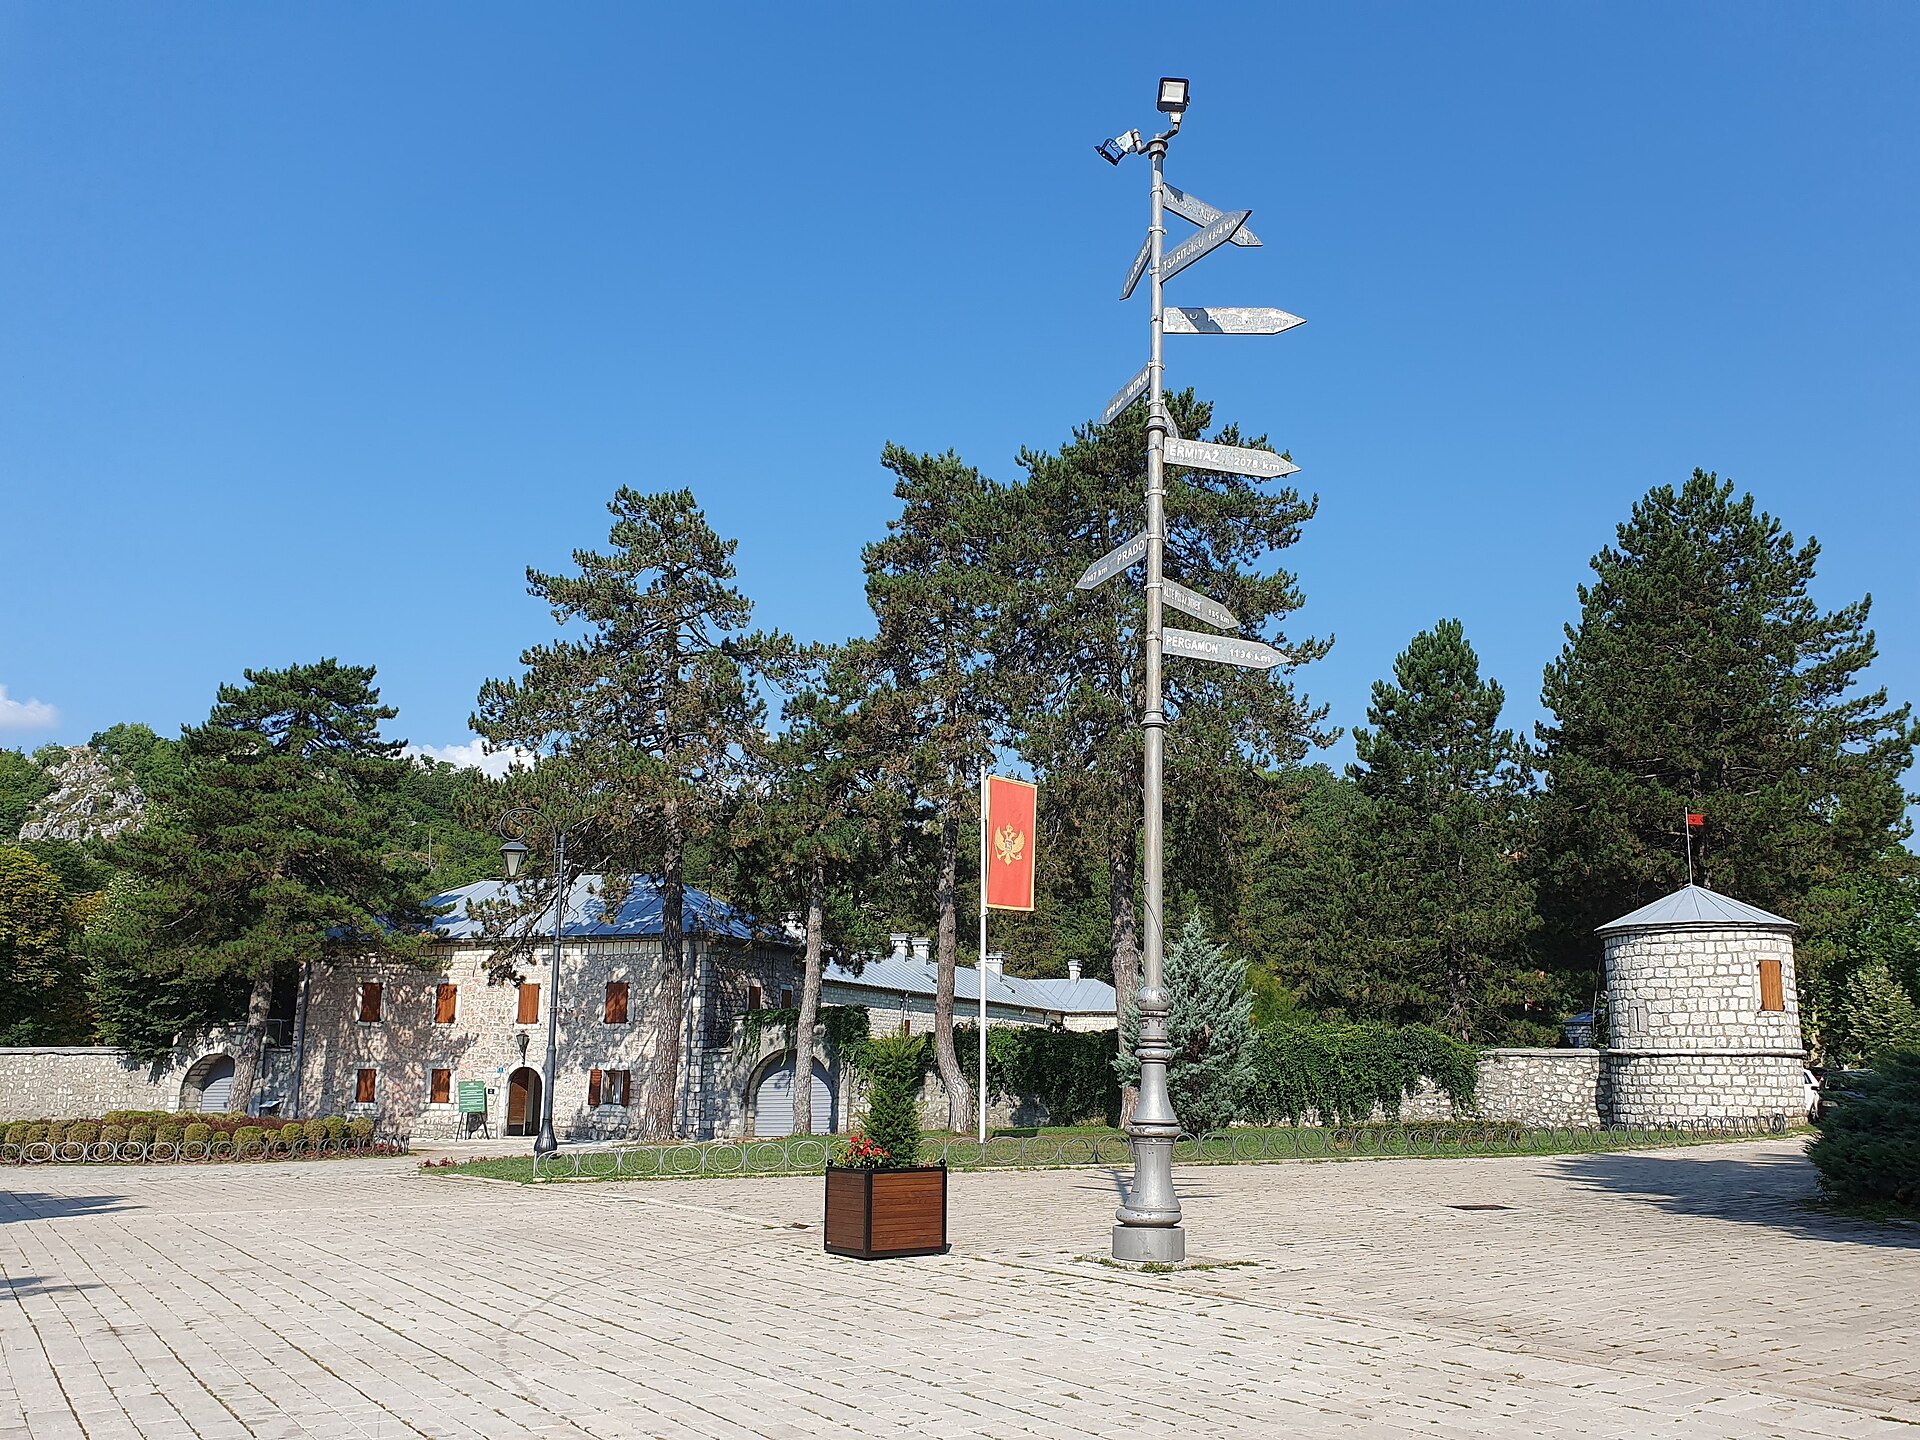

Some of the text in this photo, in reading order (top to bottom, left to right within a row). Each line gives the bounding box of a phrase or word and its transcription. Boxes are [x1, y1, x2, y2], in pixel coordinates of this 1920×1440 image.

[1169, 445, 1220, 463] ERMITAŽ
[1262, 459, 1280, 472] km
[1098, 566, 1108, 577] km
[1116, 539, 1145, 565] PRADO
[1219, 613, 1230, 625] km
[1165, 634, 1219, 655] PERGAMON
[1254, 653, 1271, 664] km
